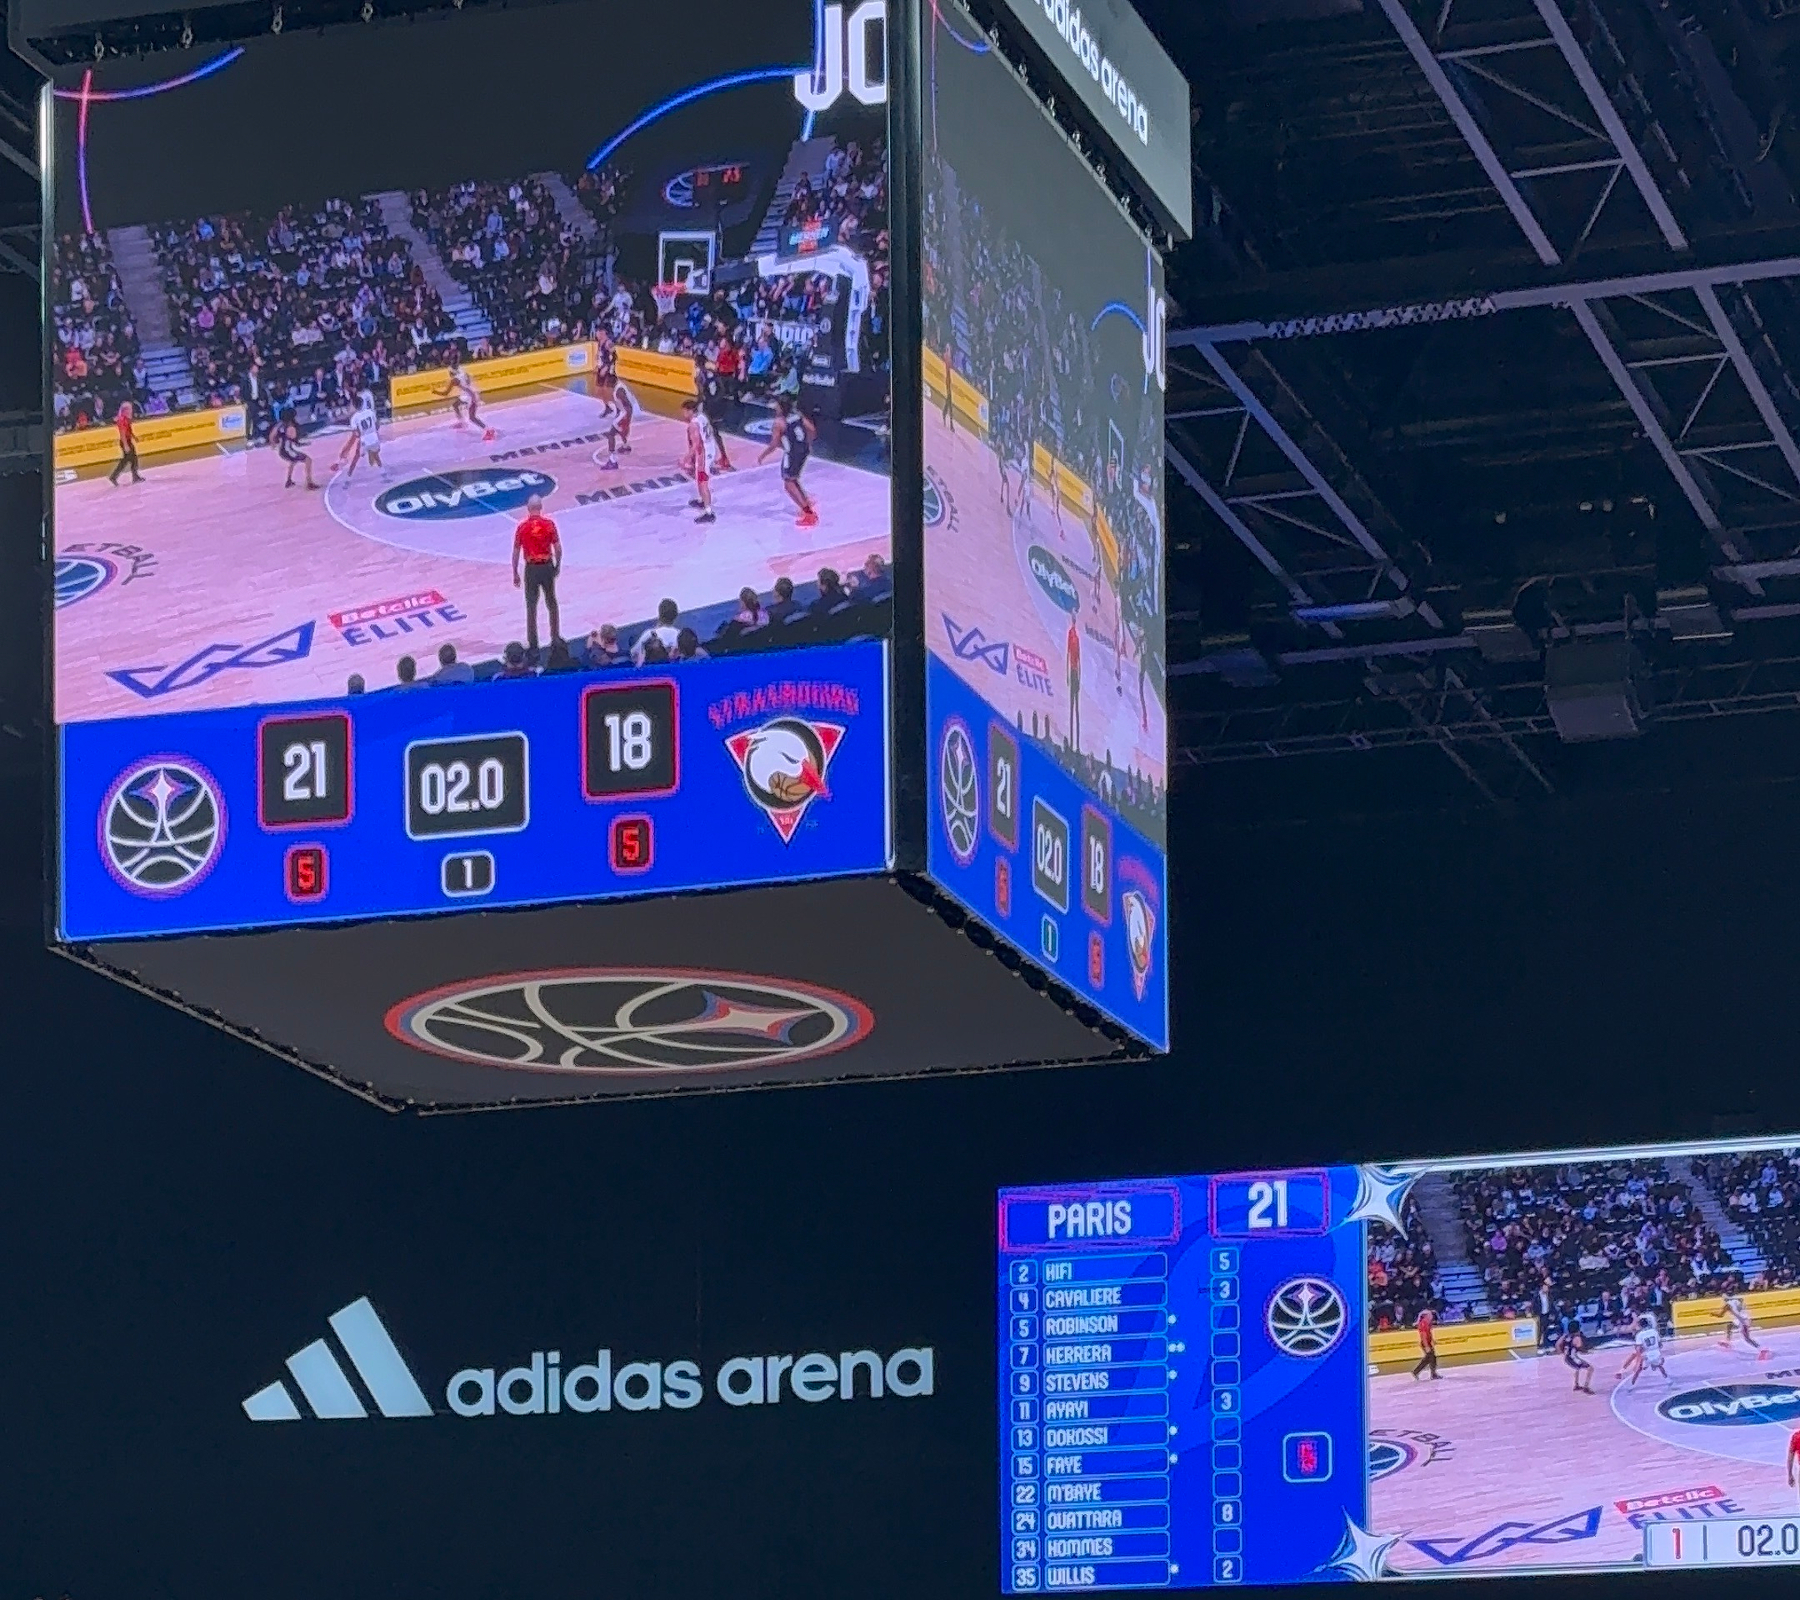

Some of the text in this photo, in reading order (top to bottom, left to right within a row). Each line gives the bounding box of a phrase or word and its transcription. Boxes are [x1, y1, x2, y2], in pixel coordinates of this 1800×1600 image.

[1101, 56, 1148, 147] arena
[386, 473, 545, 514] OlyBet
[604, 711, 652, 772] 18
[283, 741, 327, 801] 21
[420, 758, 504, 816] 02.0
[996, 757, 1012, 819] 21
[622, 827, 640, 862] 5
[1036, 822, 1063, 886] 02.0
[464, 859, 472, 889] 1
[1088, 834, 1105, 894] 18
[1047, 1200, 1132, 1239] PARIS
[1248, 1180, 1288, 1230] 21
[1018, 1264, 1028, 1283] 2
[1219, 1252, 1230, 1270] 5
[1018, 1280, 1230, 1310] 4 CAVALIERE 3
[1019, 1314, 1118, 1337] 5 ROBINSON
[1019, 1343, 1112, 1365] 7 HERRERA
[446, 1346, 935, 1417] adidas arena
[1019, 1371, 1109, 1392] 9 STEVENS
[1019, 1401, 1030, 1419] 11
[1220, 1392, 1232, 1410] 3
[1017, 1429, 1033, 1447] 13
[1017, 1454, 1083, 1475] 15 FAYE
[1016, 1485, 1035, 1503] 22
[1015, 1512, 1035, 1531] 24
[1047, 1509, 1122, 1529] OUATTARA
[1015, 1537, 1113, 1559] 34 HOMMES
[1671, 1527, 1681, 1559] 1
[1016, 1560, 1233, 1587] 35 WILLIS 2
